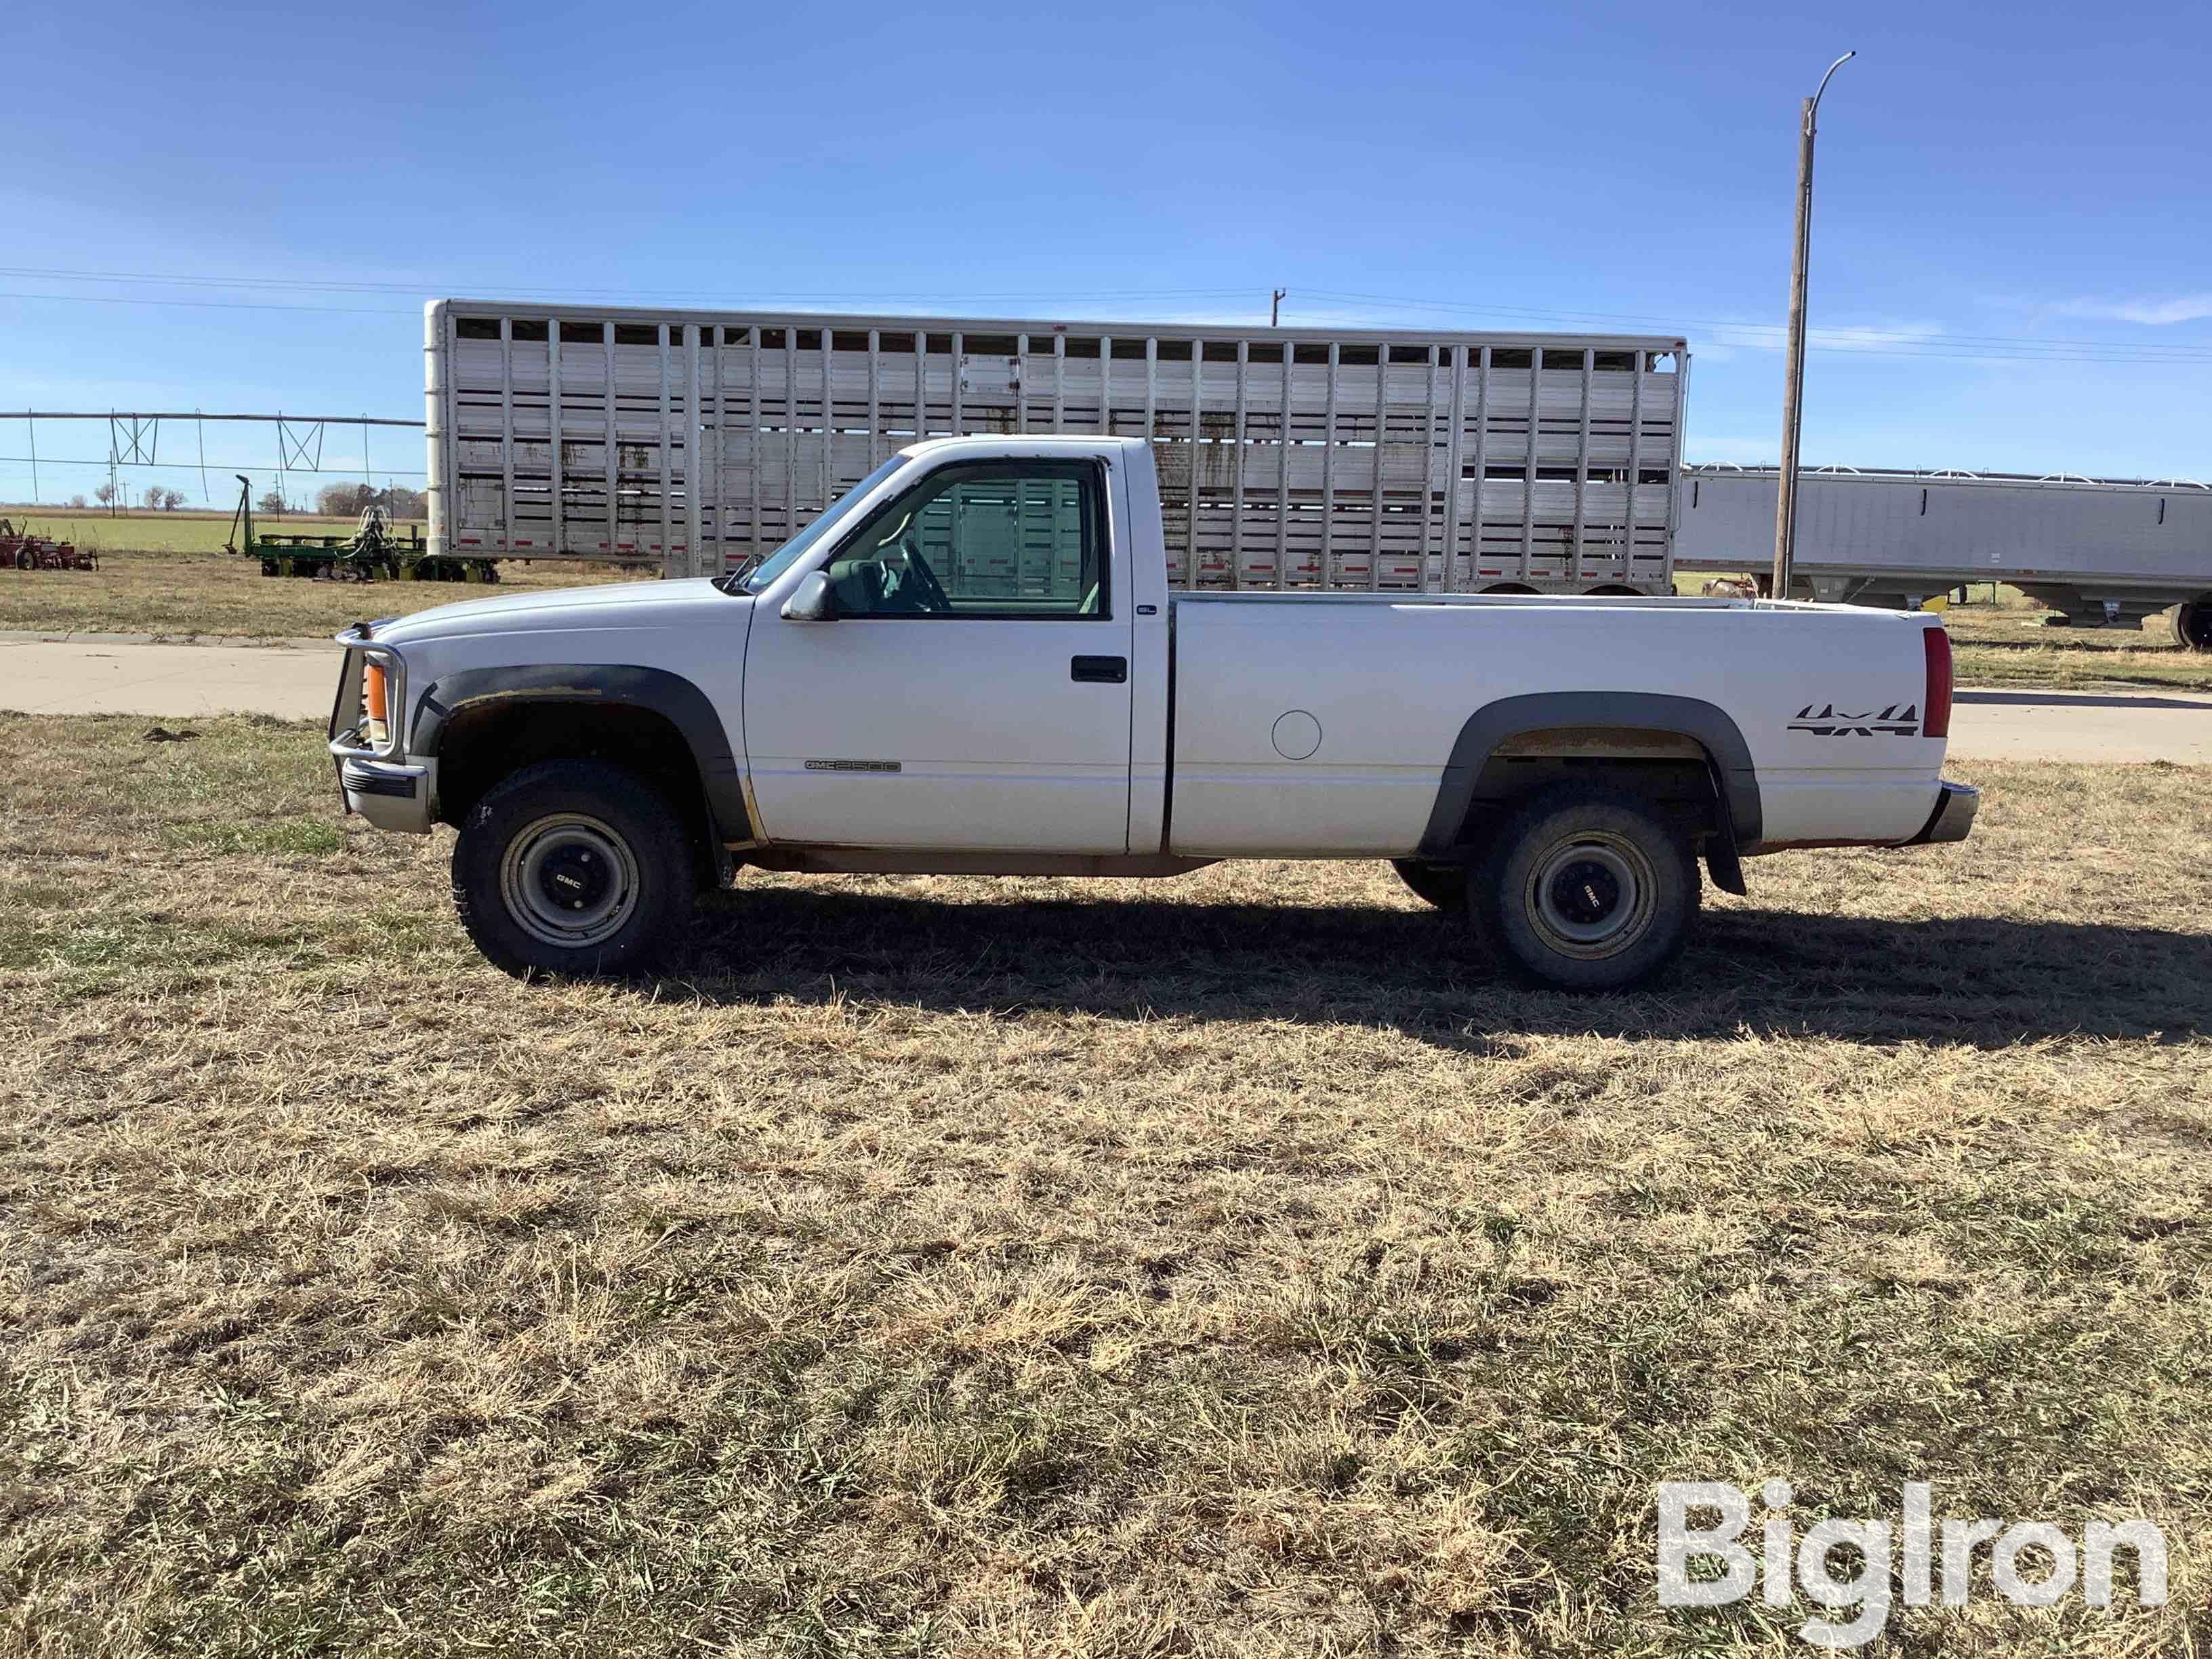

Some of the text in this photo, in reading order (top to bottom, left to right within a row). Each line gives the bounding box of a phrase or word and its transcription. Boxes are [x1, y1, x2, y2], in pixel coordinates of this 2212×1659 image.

[805, 760, 835, 770] GMC
[556, 874, 581, 889] GMC
[1584, 884, 1600, 907] GMC
